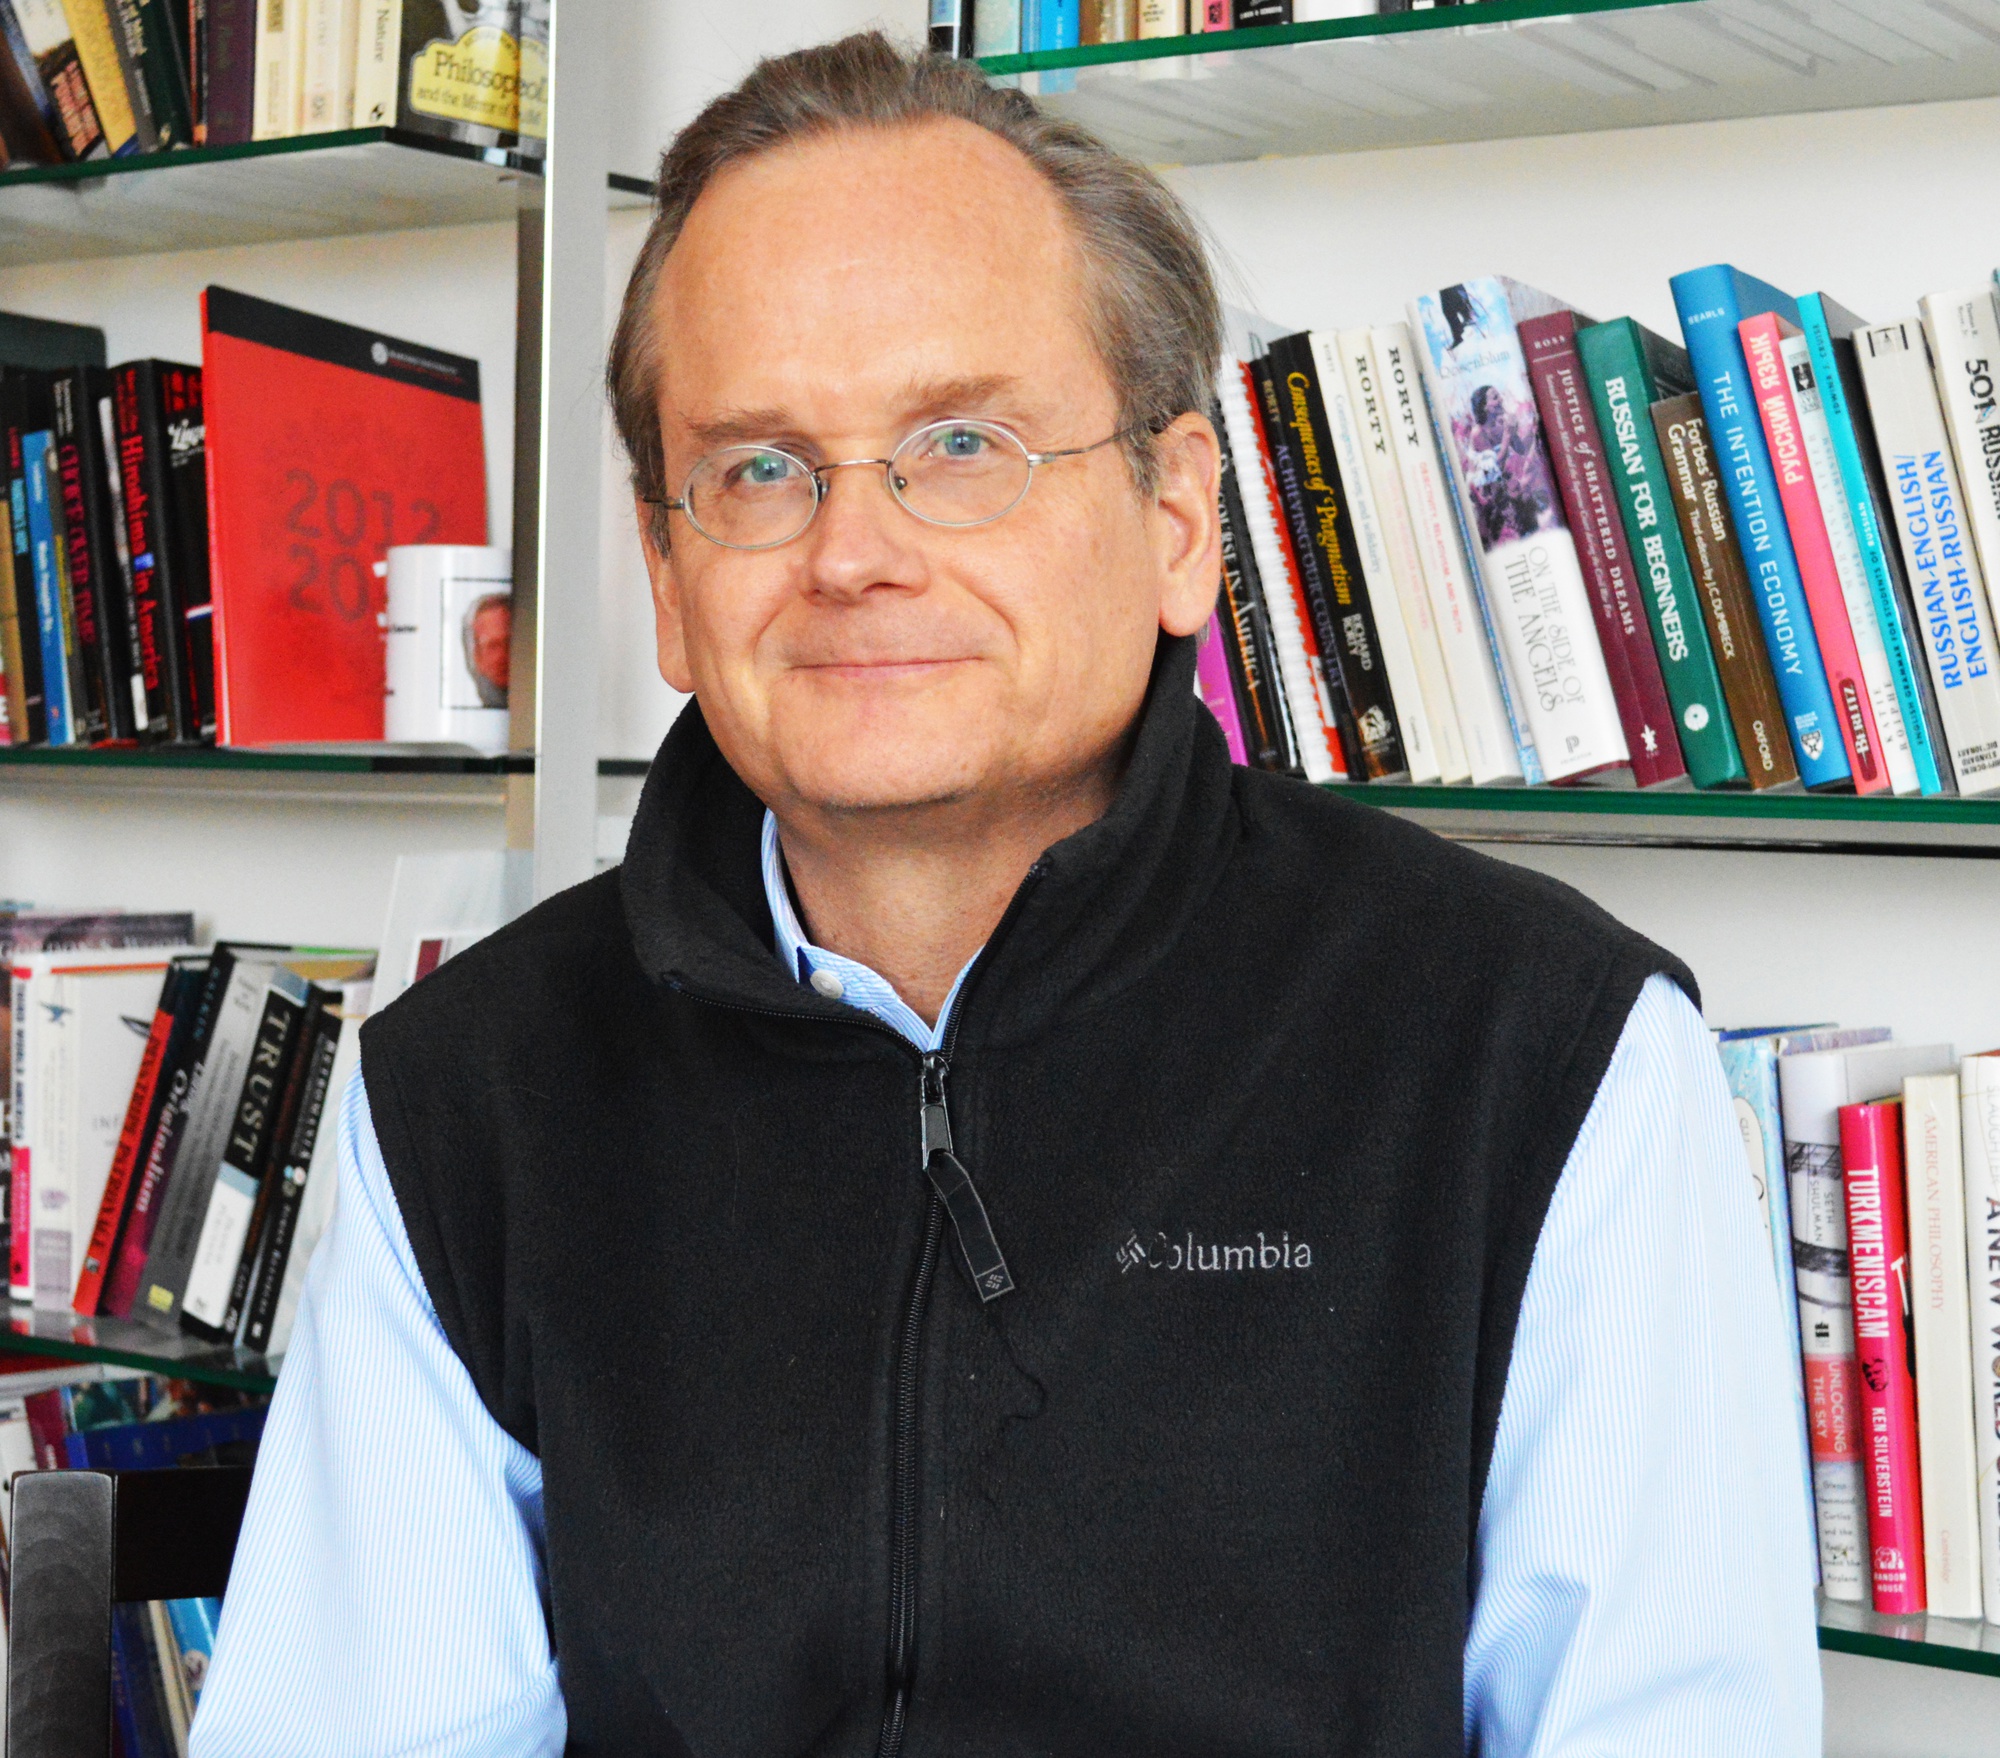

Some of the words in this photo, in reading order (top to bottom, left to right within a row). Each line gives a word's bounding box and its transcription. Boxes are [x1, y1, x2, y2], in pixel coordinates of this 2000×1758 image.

[374, 9, 390, 63] Nature
[1440, 350, 1511, 380] Rosenblum
[1534, 335, 1567, 349] ROSS
[1749, 332, 1780, 389] ЯЗЫК
[1812, 324, 1827, 358] CRUISE
[1263, 379, 1280, 422] RORTY
[1356, 356, 1386, 453] RORTY
[1388, 347, 1419, 445] RORTY
[1557, 368, 1586, 435] JUSTICE
[1826, 375, 1841, 414] EDWINA
[1965, 359, 1997, 410] 501
[1286, 371, 1322, 475] Consequences
[1574, 441, 1595, 457] of
[1605, 376, 1644, 475] RUSSIAN
[1762, 395, 1803, 484] РУССКИЙ
[1304, 476, 1333, 494] of
[1667, 423, 1698, 502] Grammar
[1808, 433, 1829, 490] AFTER
[1357, 500, 1370, 519] and
[1583, 460, 1617, 560] SHATTERED
[1630, 480, 1658, 529] FOR
[1701, 479, 1726, 541] Russian
[1713, 371, 1739, 418] THE
[1726, 425, 1772, 552] INTENTION
[1759, 559, 1803, 675] ECONOMY
[1858, 501, 1875, 547] RUSSIAN
[1276, 444, 1312, 548] ACHIEVING
[1302, 552, 1322, 594] OUR
[1313, 597, 1344, 687] COUNTRY
[1315, 496, 1352, 605] Pragmatism
[1363, 522, 1381, 573] solidarity
[1529, 547, 1552, 578] ON
[1827, 504, 1854, 589] MORNING
[1869, 550, 1879, 563] OF
[1893, 453, 1961, 690] RUSSIAN-ENGLISH/
[1923, 450, 1987, 680] ENGLISH-RUSSIAN
[1505, 554, 1537, 603] THE
[1539, 583, 1562, 618] THE
[1609, 566, 1635, 634] DREAMS
[1643, 533, 1688, 661] BEGINNERS
[1873, 567, 1892, 617] STUDENTS
[1446, 582, 1456, 601] AND
[1452, 604, 1462, 633] TRUTH
[1851, 605, 1865, 636] THE
[1887, 621, 1897, 641] FOR
[1231, 600, 1260, 690] AMERICA
[1342, 615, 1360, 655] RORTY
[1350, 613, 1372, 670] RICHARD
[1550, 625, 1576, 670] SIDE
[1518, 614, 1564, 712] ANGELS
[1563, 675, 1585, 704] OF
[1893, 645, 1912, 697] GRAMMAR
[1873, 689, 1893, 742] KATIE
[1884, 679, 1908, 751] ROIPHE
[1908, 701, 1924, 745] ENGLISH
[1752, 720, 1774, 771] OXFORD
[233, 1012, 291, 1162] TRUST
[135, 1069, 187, 1213] Originalism
[1924, 1116, 1938, 1201] AMERICAN
[1809, 1179, 1822, 1243] SHULMAN
[1823, 1192, 1835, 1226] SETH
[1847, 1165, 1890, 1340] TURKMENISCAM
[1927, 1207, 1943, 1310] PHILOSOPHY
[1813, 1377, 1826, 1407] THE
[1828, 1363, 1848, 1454] UNLOCKING
[1815, 1409, 1828, 1440] SKY
[1872, 1406, 1887, 1434] KEN
[1874, 1436, 1893, 1518] SILVERSTEIN
